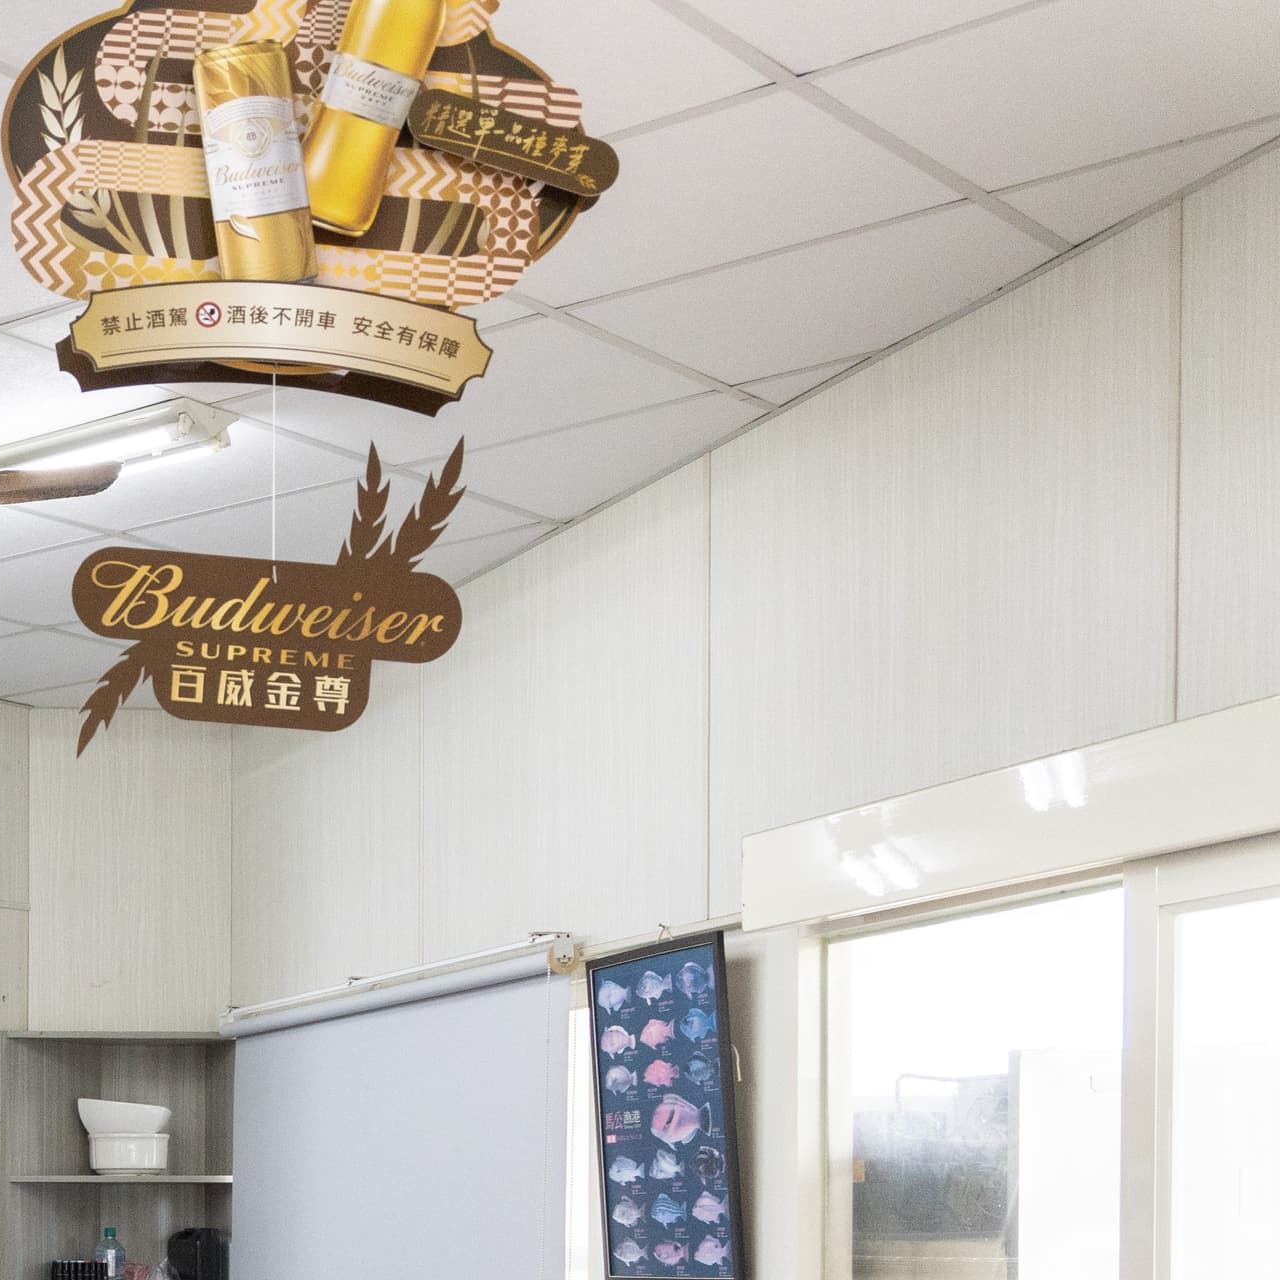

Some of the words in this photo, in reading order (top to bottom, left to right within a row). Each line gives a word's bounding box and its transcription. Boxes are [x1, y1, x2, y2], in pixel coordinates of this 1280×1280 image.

[100, 306, 189, 336] 禁止酒駕
[226, 305, 338, 331] 酒後不開車
[351, 315, 462, 360] 安全有保障
[91, 560, 445, 646] Budweiser
[176, 641, 355, 670] SUPREME
[170, 664, 351, 715] 百威金尊
